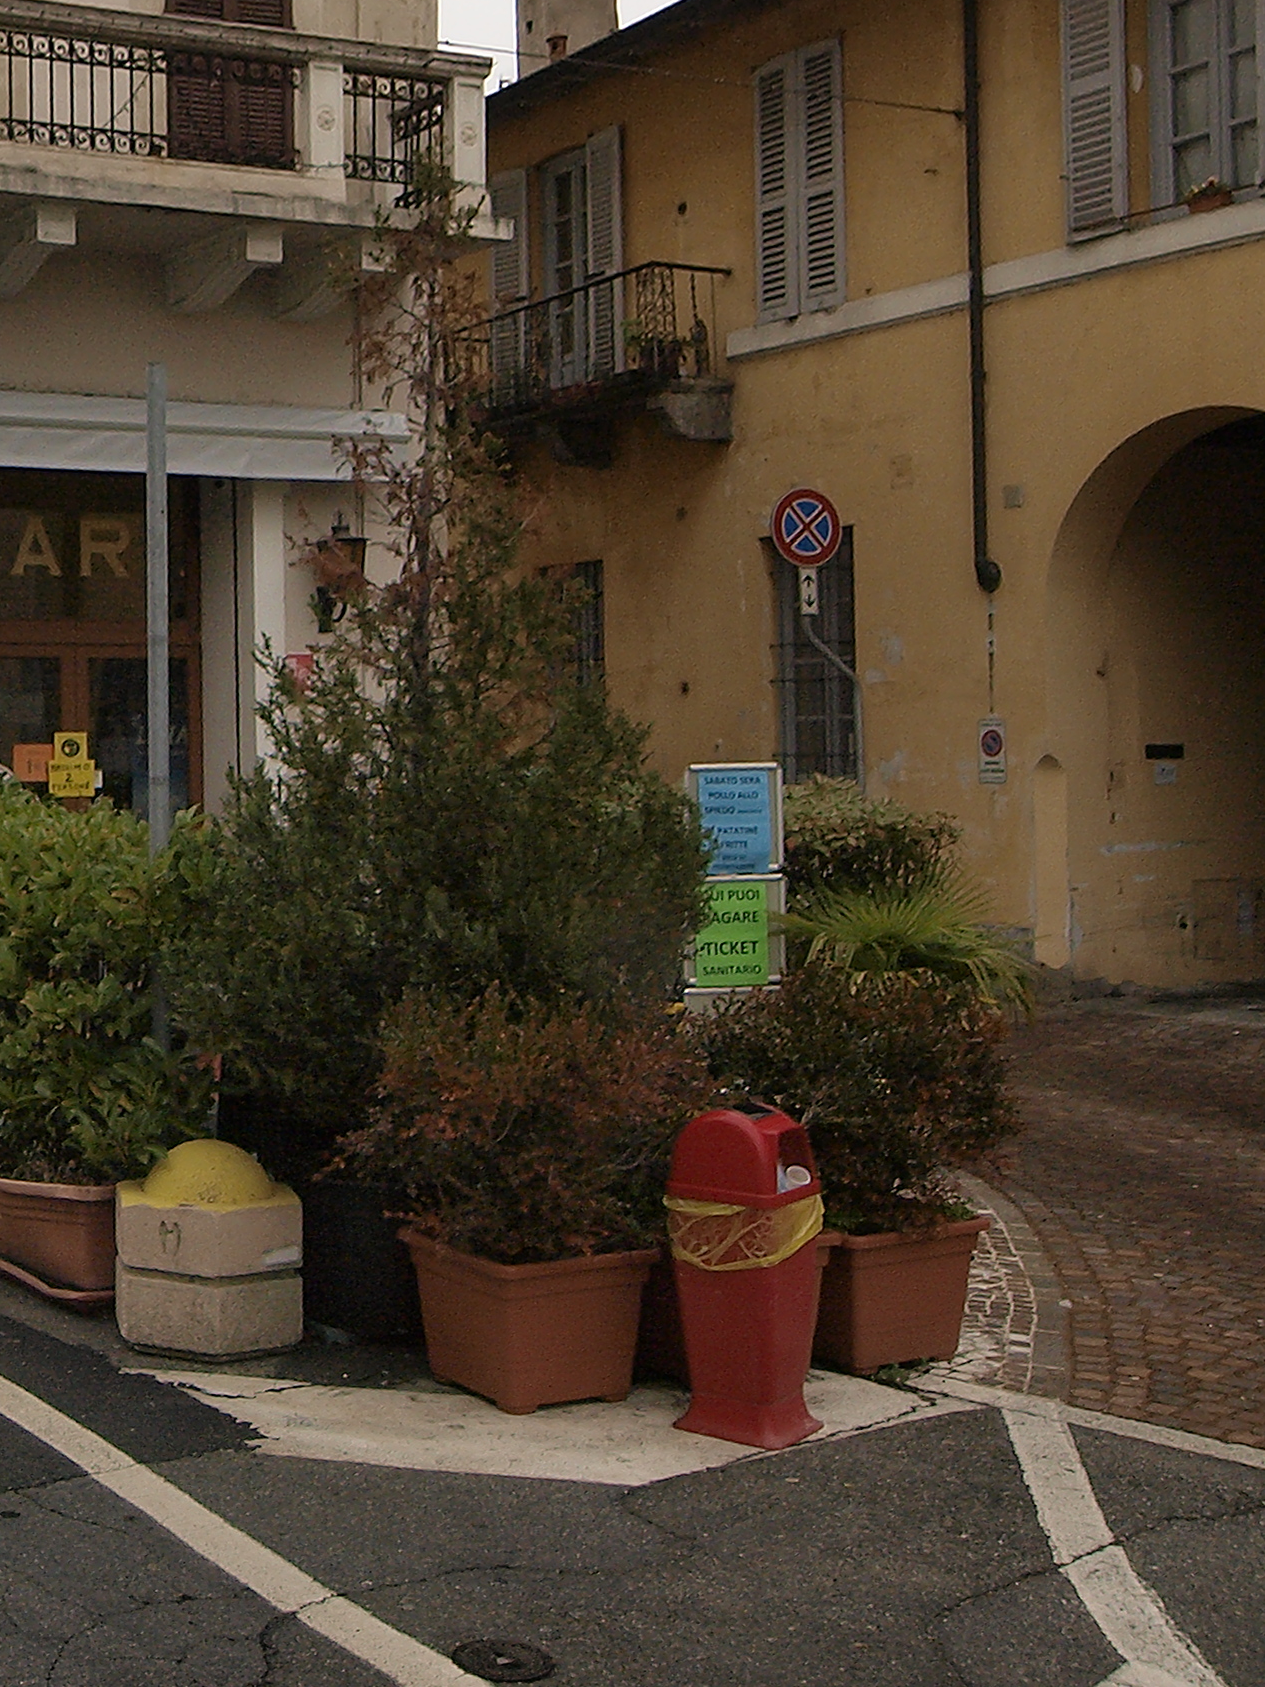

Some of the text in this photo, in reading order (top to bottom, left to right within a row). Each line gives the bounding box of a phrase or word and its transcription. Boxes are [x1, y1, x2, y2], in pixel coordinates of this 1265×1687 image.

[65, 772, 74, 782] 2
[728, 889, 760, 901] PUOI
[712, 910, 759, 924] AGARE
[704, 940, 759, 955] TICKET
[703, 964, 762, 976] SANITARIO
